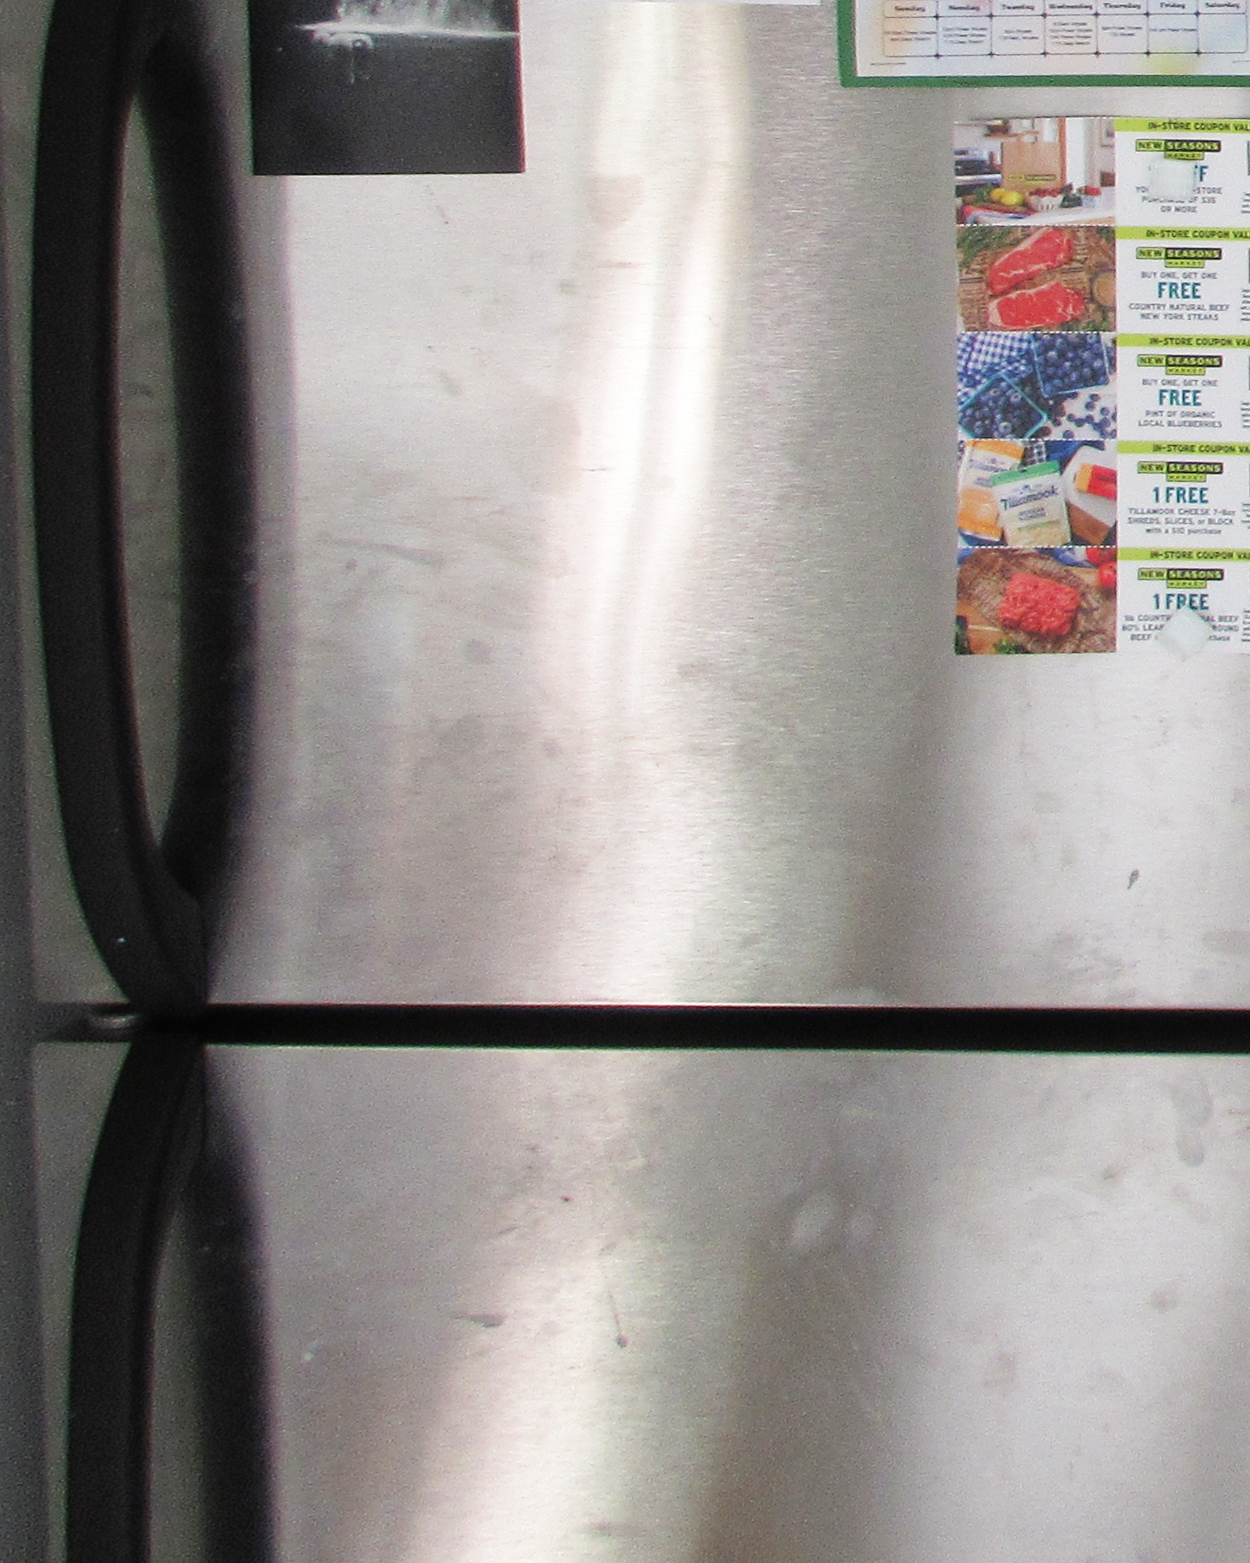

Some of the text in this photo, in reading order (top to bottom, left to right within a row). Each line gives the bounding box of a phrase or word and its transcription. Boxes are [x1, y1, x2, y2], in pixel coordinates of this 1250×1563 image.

[1194, 122, 1230, 131] COUPON
[1192, 230, 1230, 239] COUPON
[1158, 282, 1201, 299] FREE
[1196, 338, 1232, 346] COUPON
[1158, 389, 1202, 406] FREE
[1198, 444, 1235, 453] COUPON
[1152, 486, 1209, 504] 1 FREE
[1196, 551, 1233, 560] COUPON
[1152, 593, 1209, 610] 1 FREE
